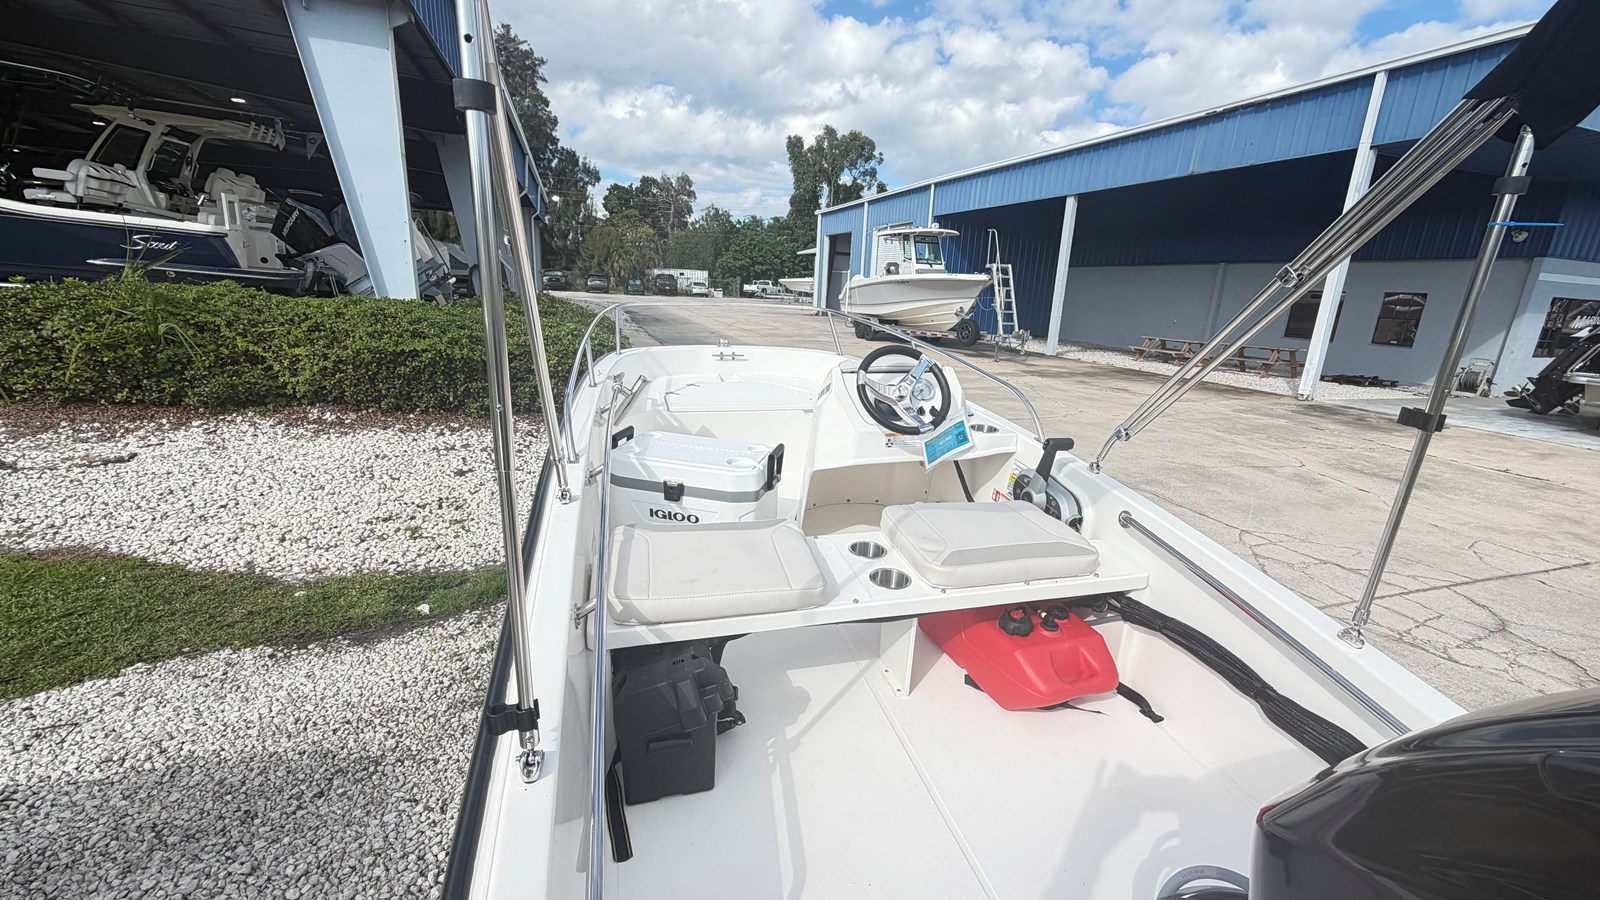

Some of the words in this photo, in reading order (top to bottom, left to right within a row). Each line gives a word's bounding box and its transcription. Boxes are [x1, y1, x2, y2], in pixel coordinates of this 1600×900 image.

[281, 208, 300, 237] MERCURY
[120, 234, 181, 251] Scout
[649, 507, 700, 524] IGLOO
